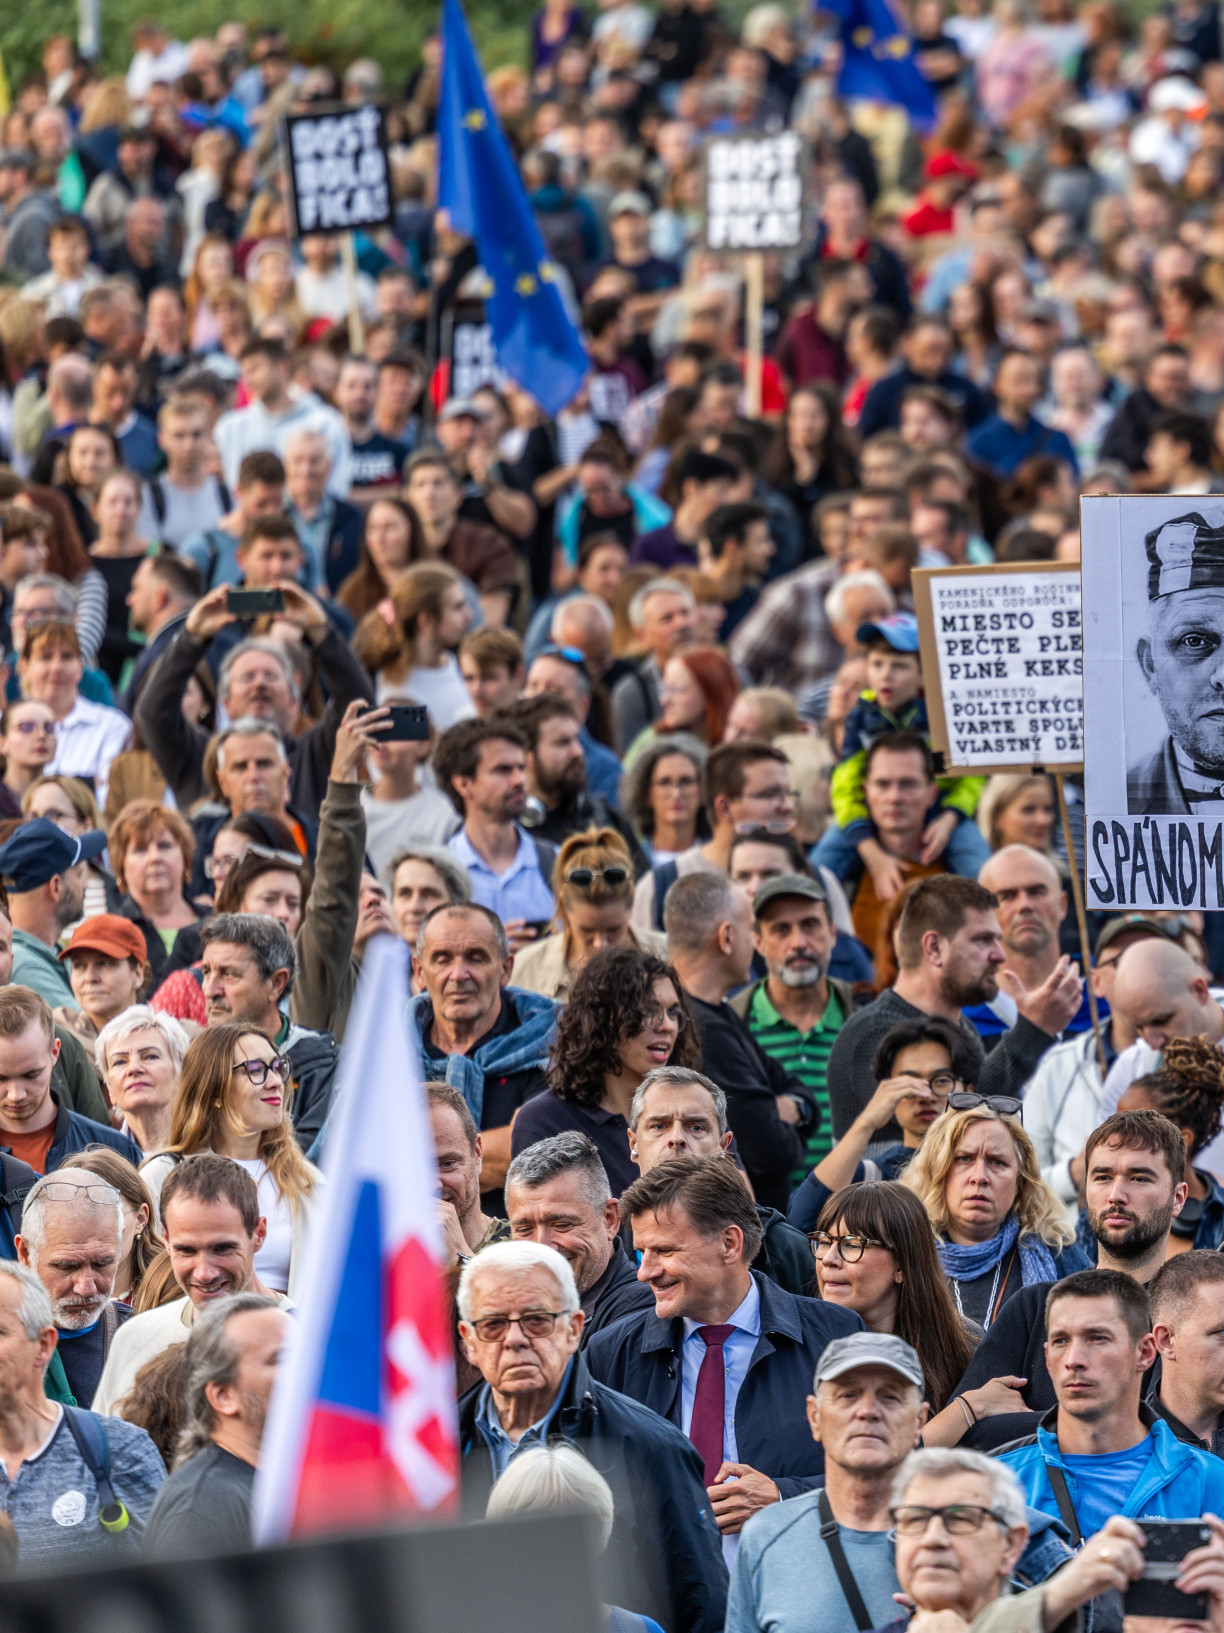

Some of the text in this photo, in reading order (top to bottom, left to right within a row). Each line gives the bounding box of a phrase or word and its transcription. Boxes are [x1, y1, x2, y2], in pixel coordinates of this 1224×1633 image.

[941, 612, 1034, 632] MIESTO
[945, 634, 1021, 656] PEČTE
[949, 656, 1008, 680] PLNÉ
[950, 687, 1036, 699] A NAMIESTO
[954, 720, 1016, 735] VARTE
[956, 734, 1041, 753] VLASTNÝ
